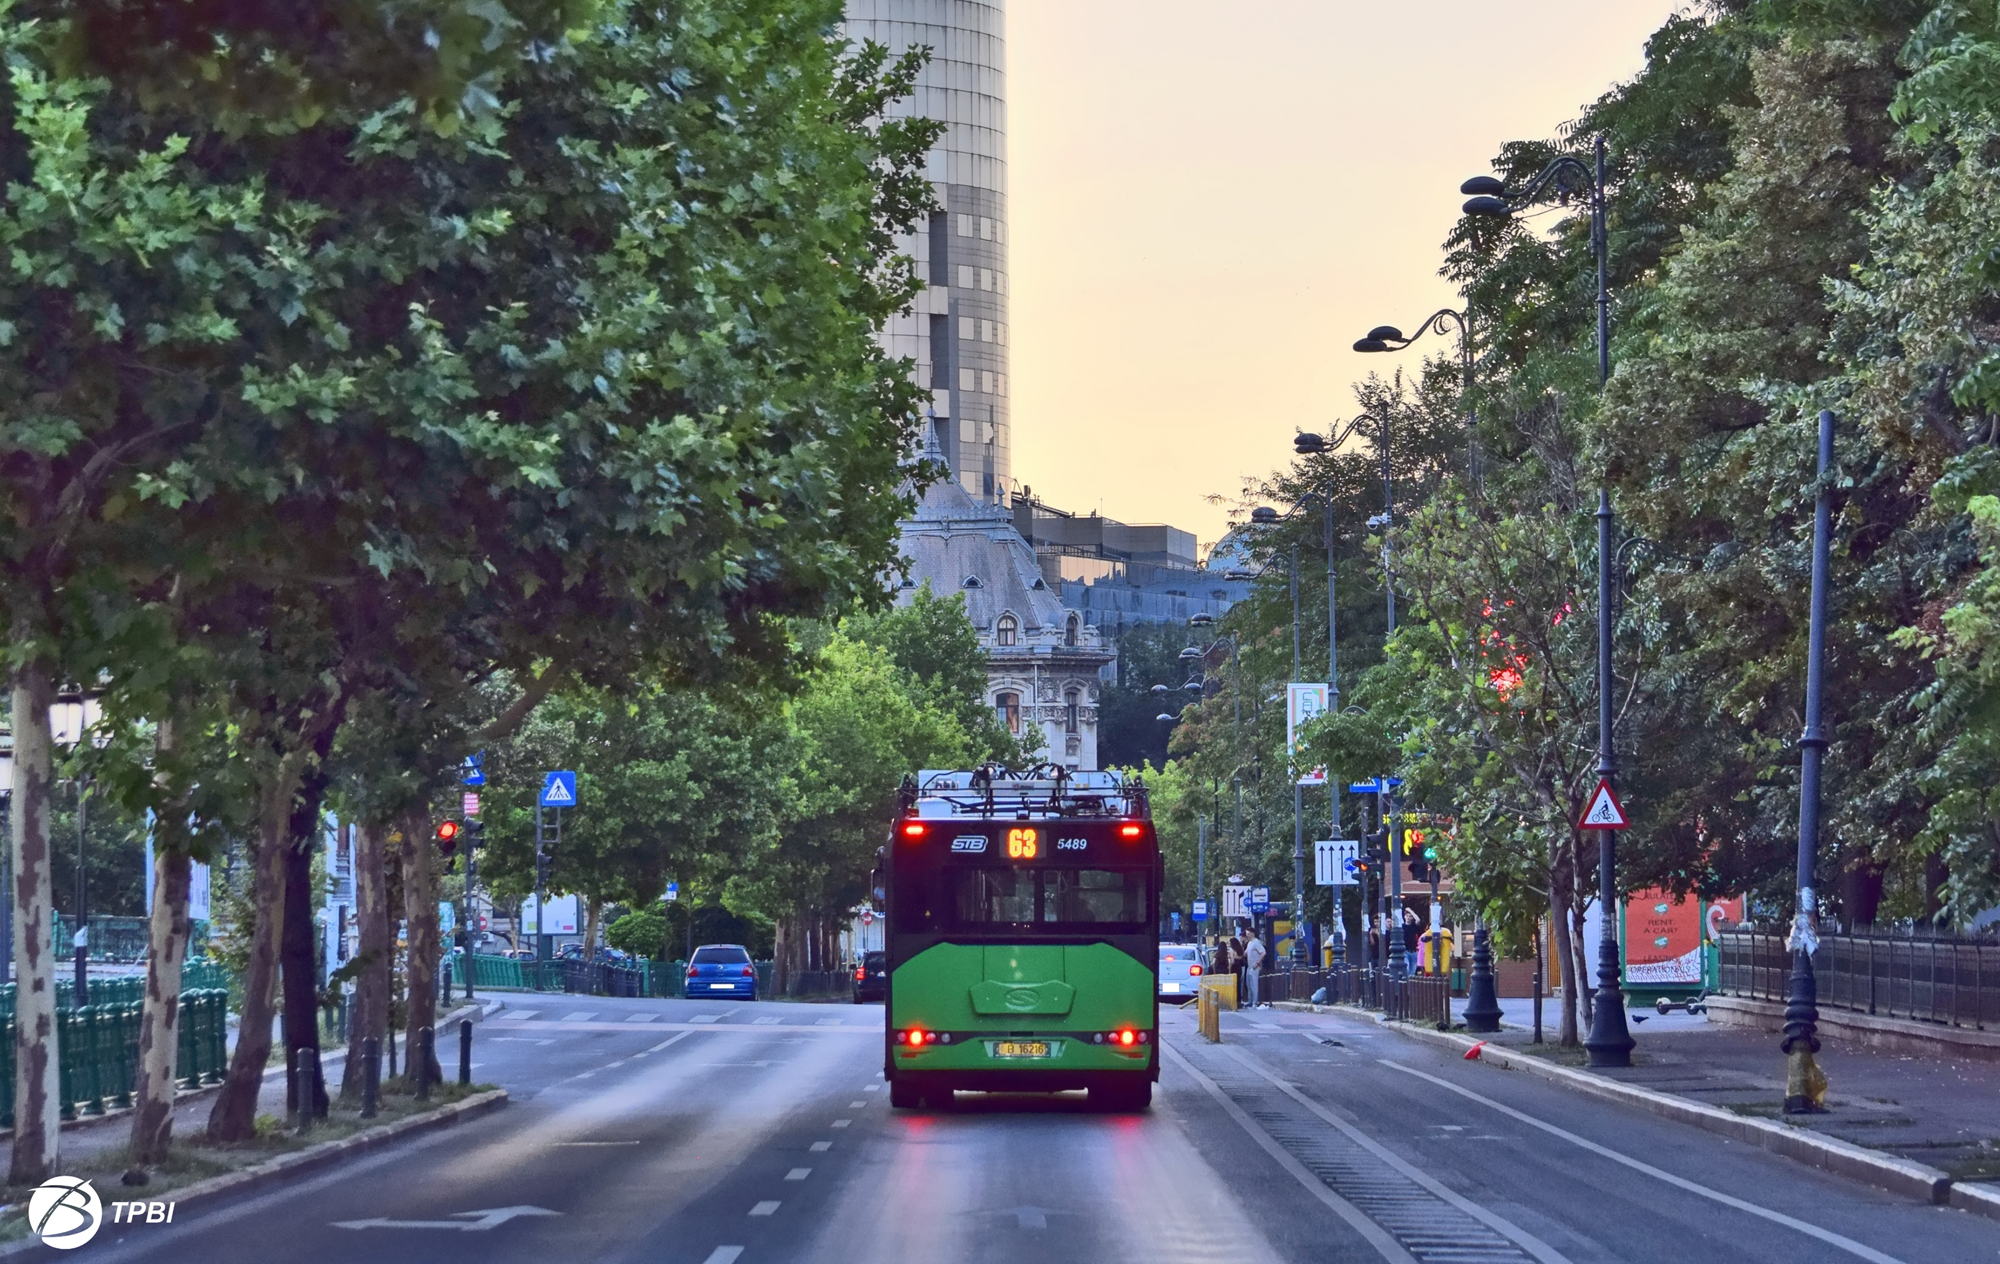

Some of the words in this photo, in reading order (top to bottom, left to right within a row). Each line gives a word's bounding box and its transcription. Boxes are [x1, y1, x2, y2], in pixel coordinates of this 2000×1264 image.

[951, 837, 987, 851] STB
[1009, 829, 1036, 858] 63
[1057, 838, 1087, 850] 5489
[1007, 1045, 1015, 1054] B
[1018, 1045, 1044, 1054] 16216
